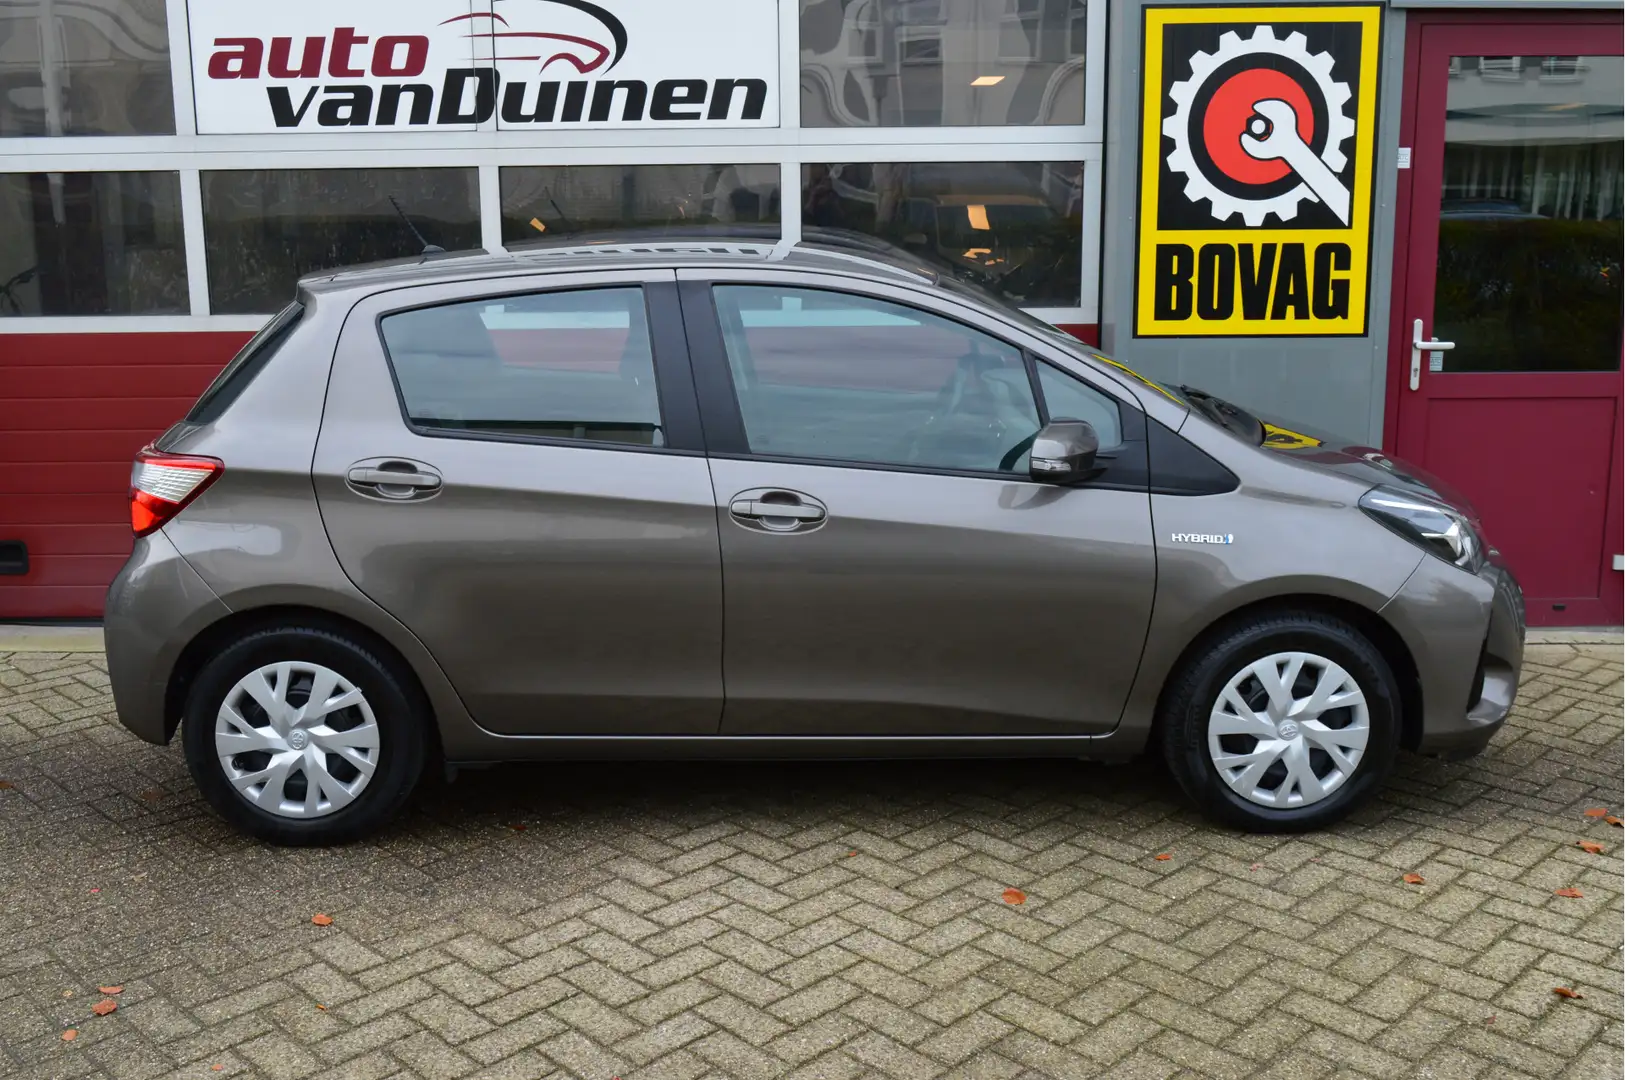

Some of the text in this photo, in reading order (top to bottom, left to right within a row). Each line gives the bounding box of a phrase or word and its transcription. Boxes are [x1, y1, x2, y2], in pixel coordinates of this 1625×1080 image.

[207, 26, 430, 80] auto
[265, 68, 768, 128] vanDuinen
[1154, 242, 1352, 321] BOVAG
[1171, 533, 1224, 544] HYBRID
